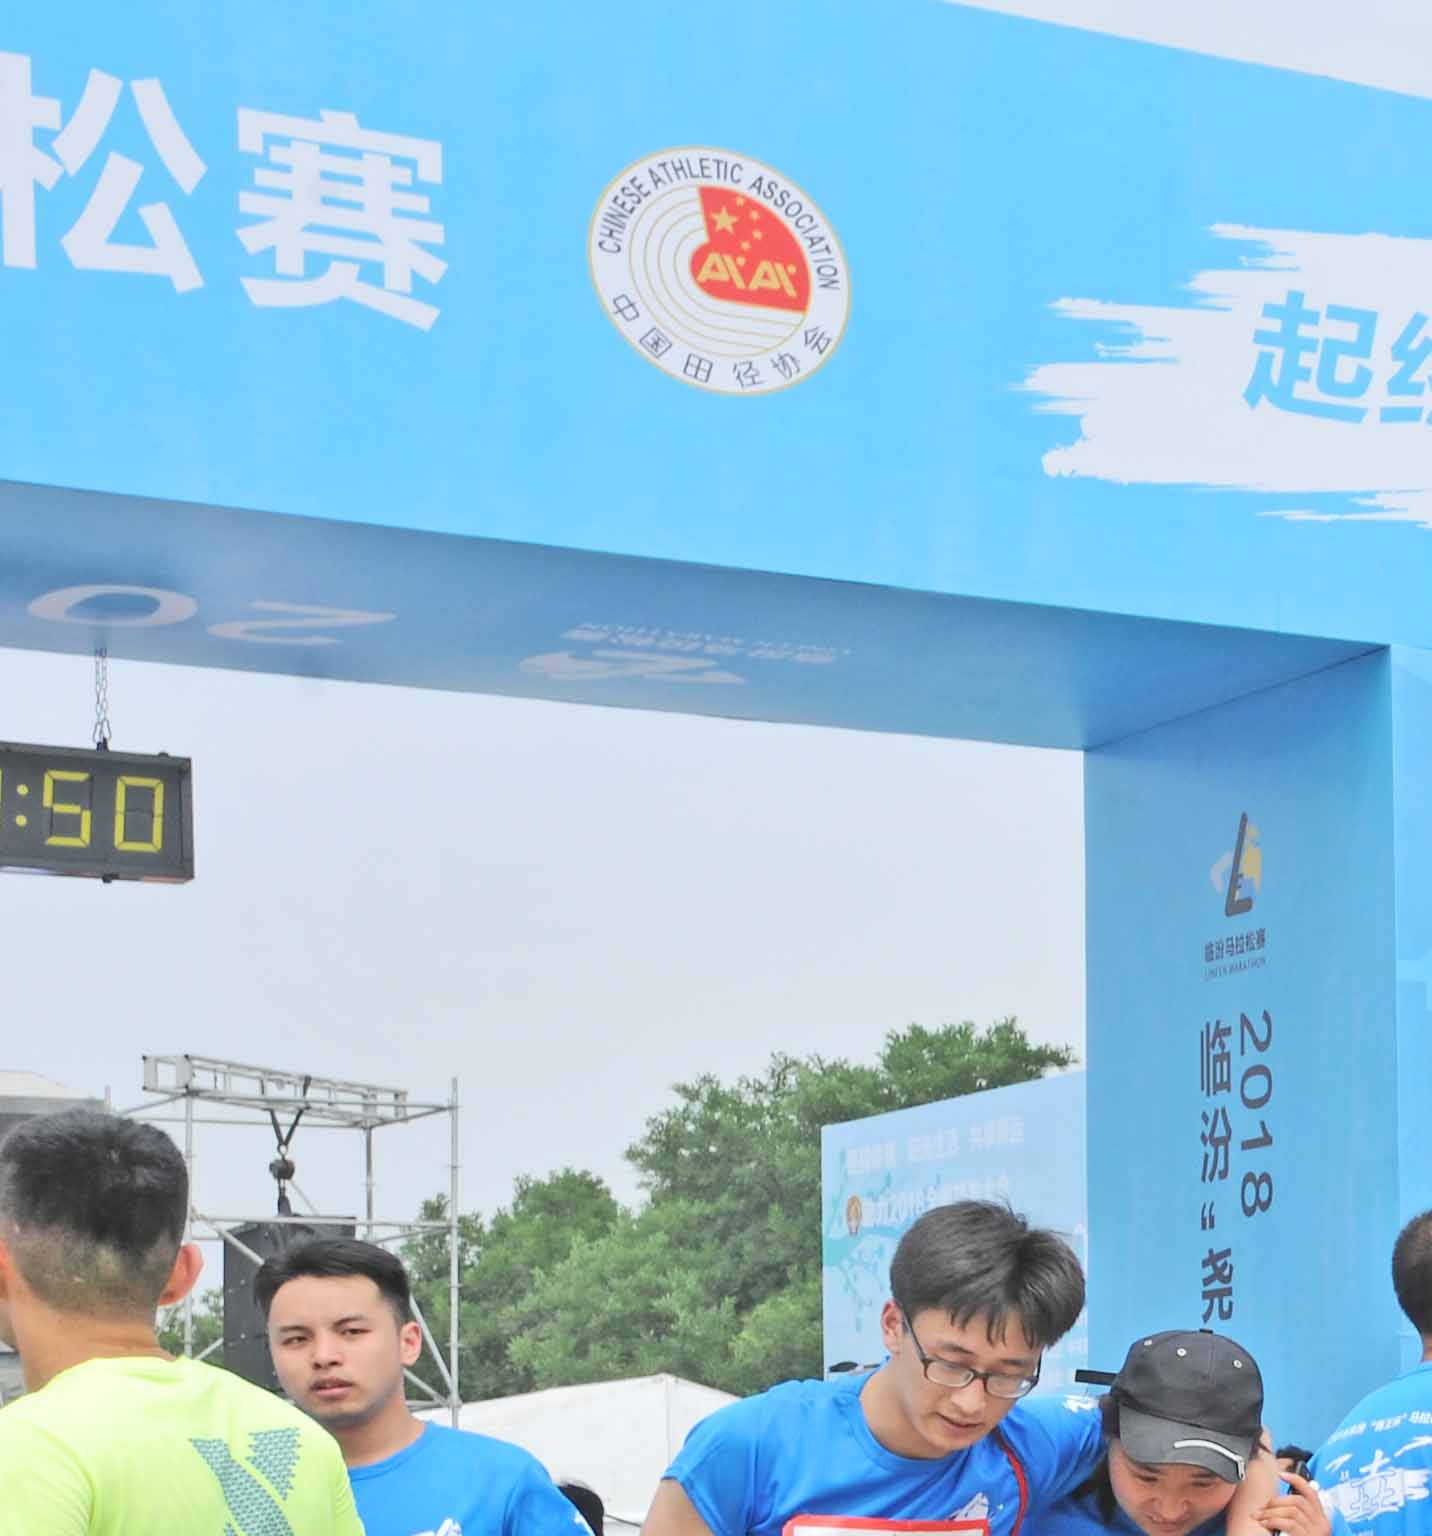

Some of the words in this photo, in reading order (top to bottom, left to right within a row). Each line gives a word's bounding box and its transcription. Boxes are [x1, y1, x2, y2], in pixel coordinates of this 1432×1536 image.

[0, 51, 448, 332] 松赛
[598, 176, 651, 254] CHINESE
[648, 158, 744, 190] ATHLETIC
[749, 176, 841, 291] ASSOCIATION
[612, 294, 831, 389] 中国田径协会
[0, 768, 164, 853] :50
[1240, 1009, 1273, 1217] 2018
